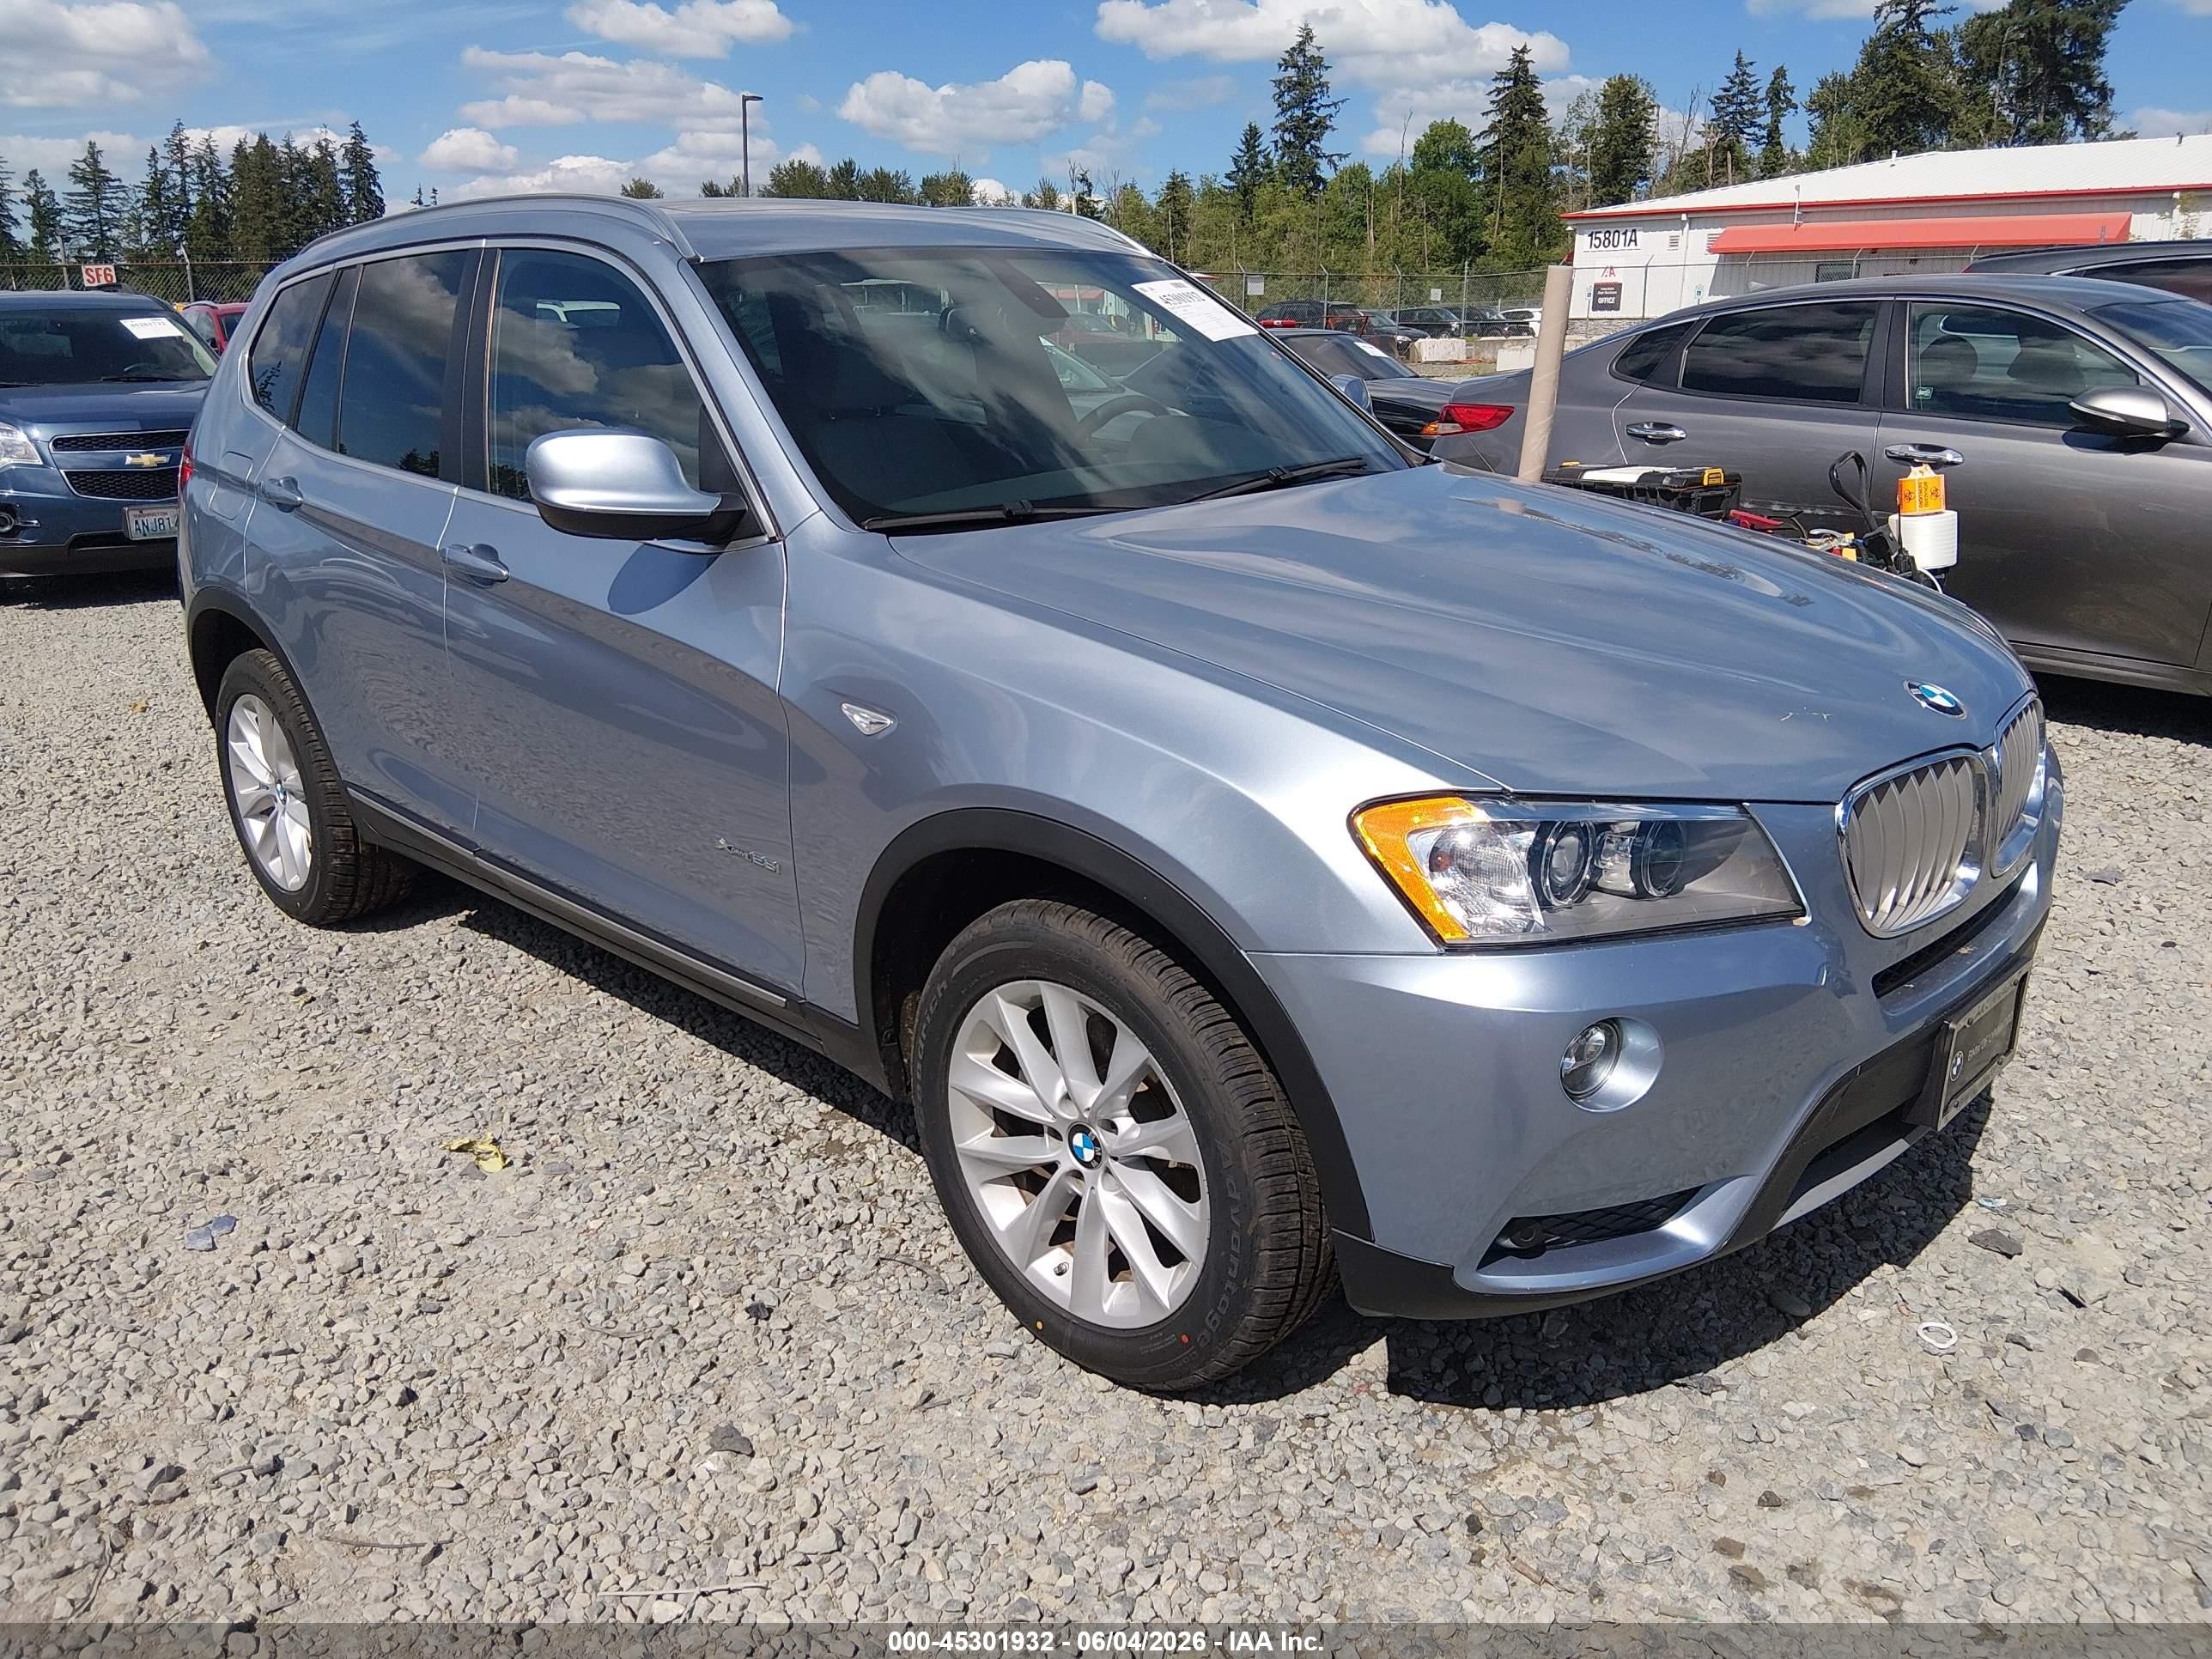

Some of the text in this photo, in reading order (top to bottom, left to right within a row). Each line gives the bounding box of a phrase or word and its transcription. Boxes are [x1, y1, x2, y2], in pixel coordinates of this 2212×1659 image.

[1588, 228, 1638, 249] 15801A
[84, 267, 114, 284] SF6
[1196, 1139, 1242, 1347] Advantage
